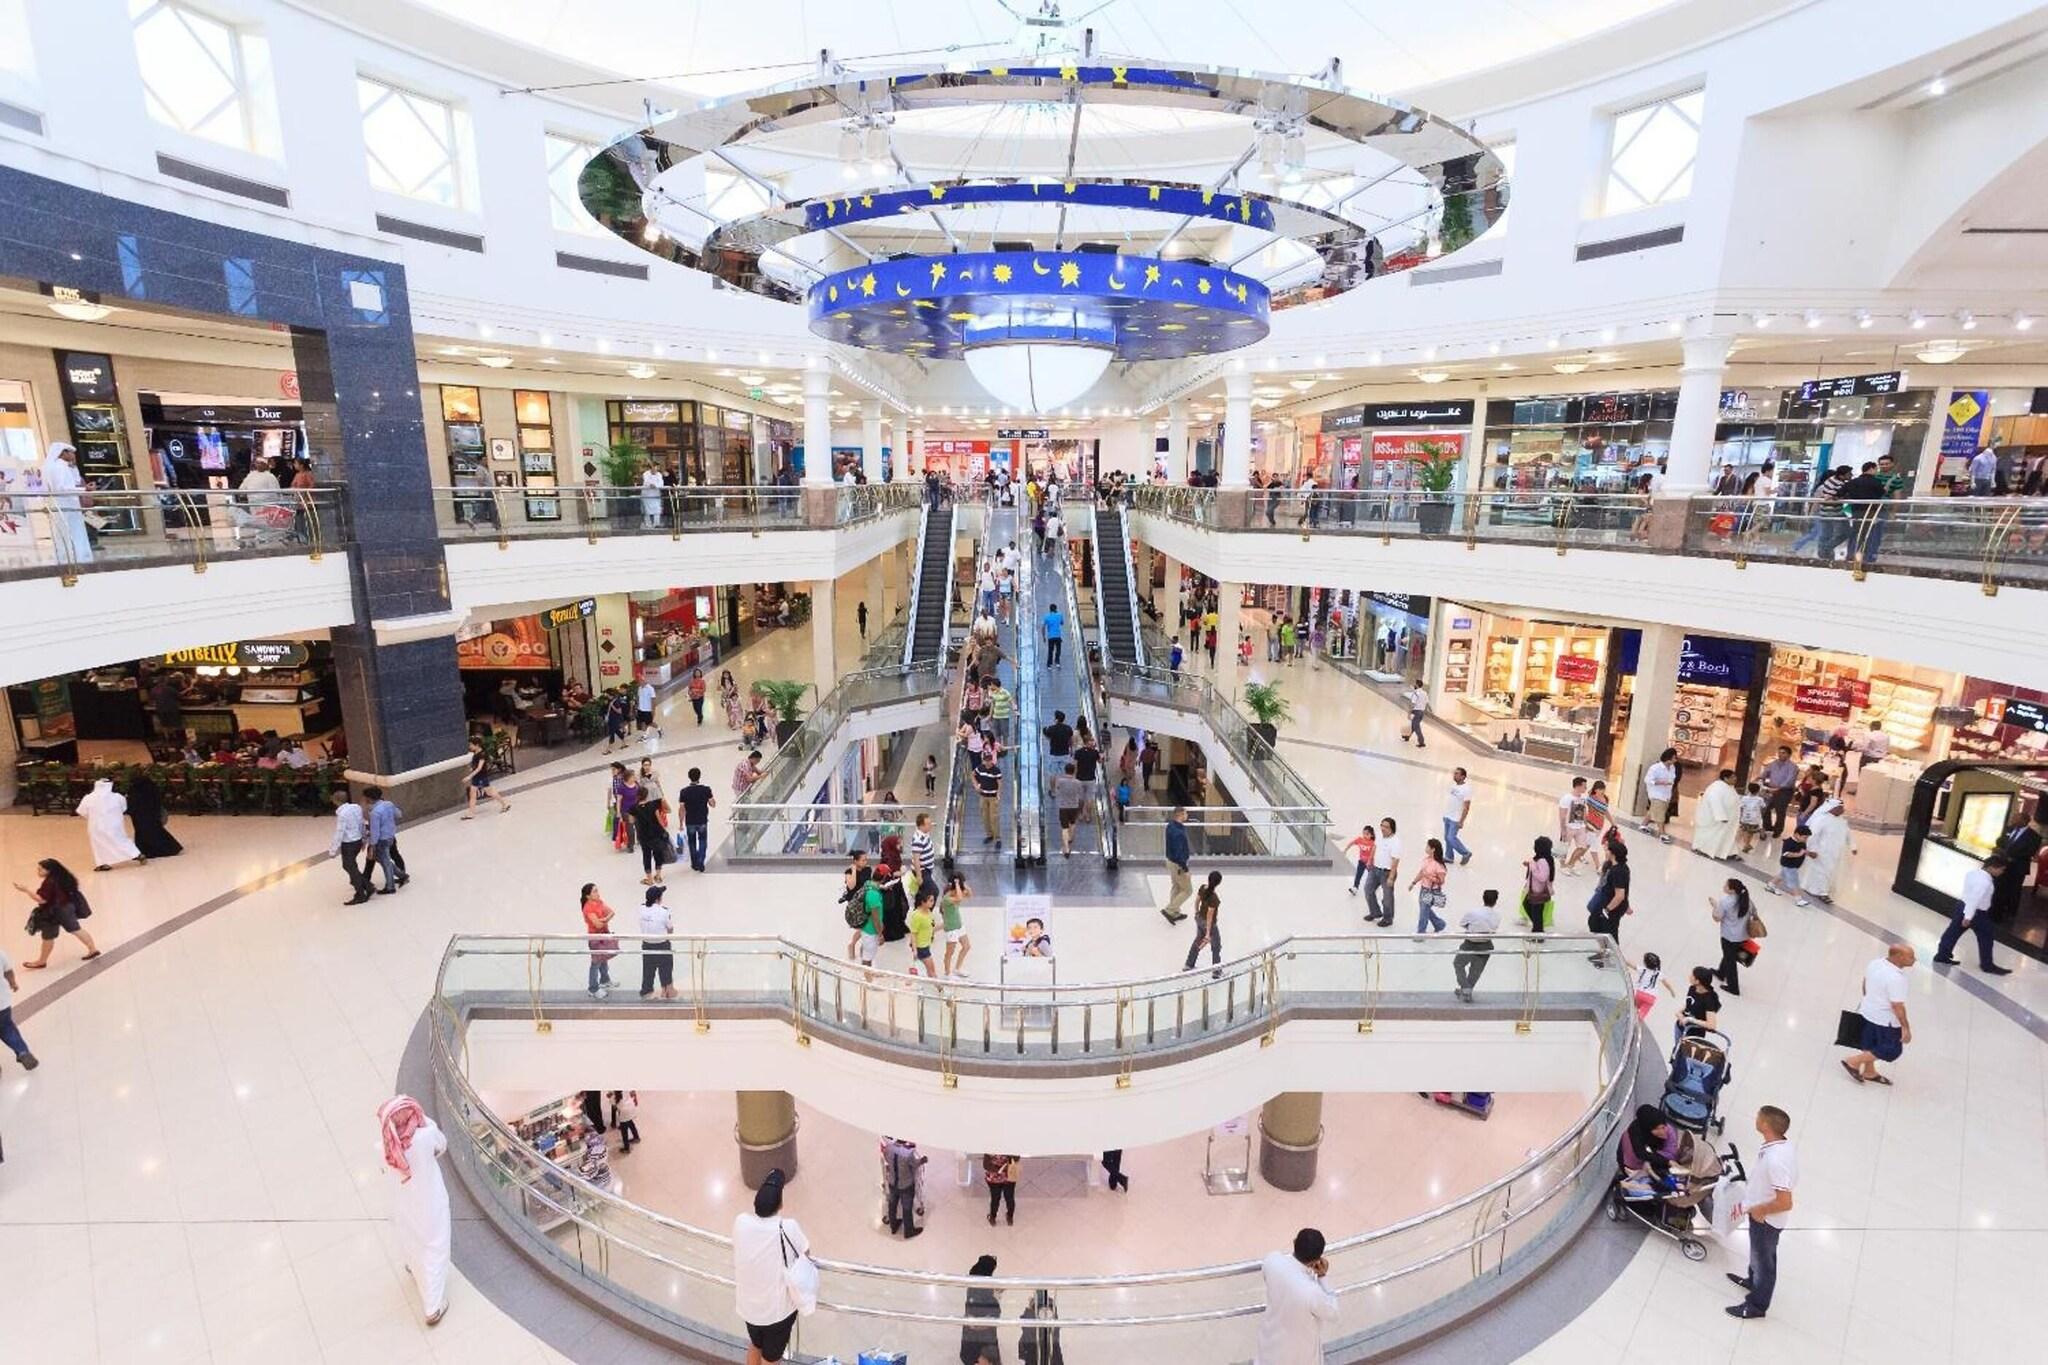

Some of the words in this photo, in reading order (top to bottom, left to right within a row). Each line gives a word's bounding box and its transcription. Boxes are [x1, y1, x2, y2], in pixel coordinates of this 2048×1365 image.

[254, 407, 282, 419] Dior
[165, 642, 238, 664] POTBELLY
[244, 644, 291, 655] SANDWICH
[257, 654, 281, 663] SHOP
[1698, 660, 1730, 674] Boch
[1807, 688, 1841, 699] SPECIAL
[1796, 695, 1849, 708] PROMOTION
